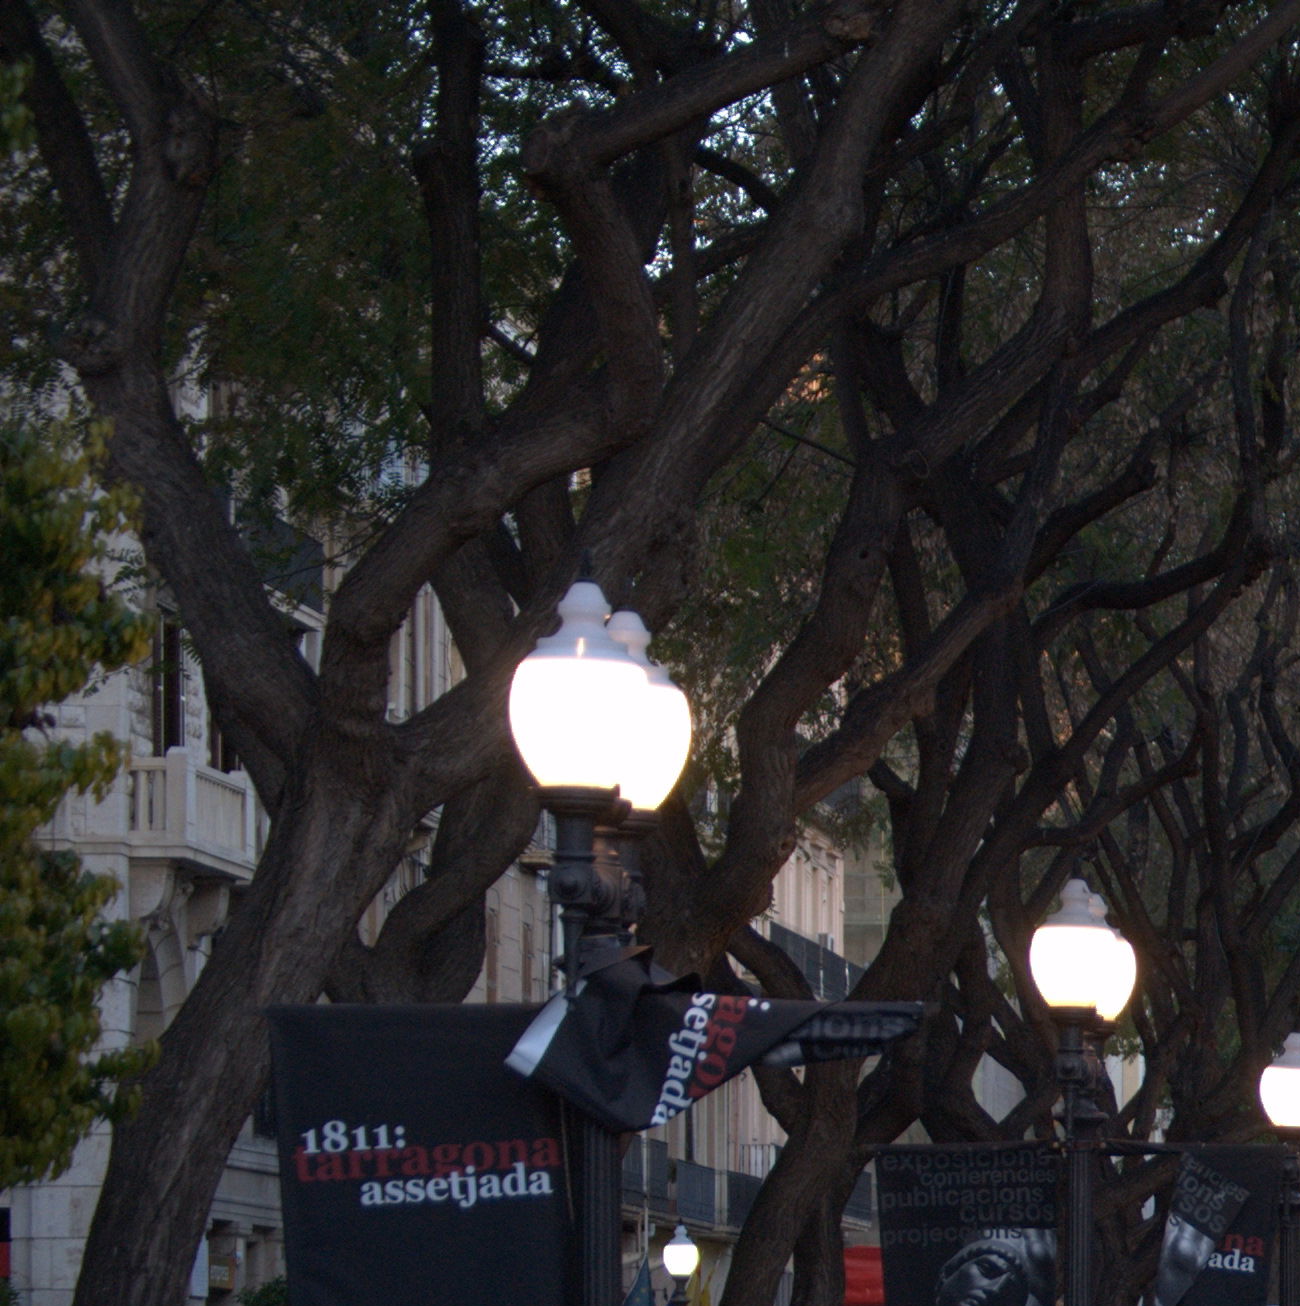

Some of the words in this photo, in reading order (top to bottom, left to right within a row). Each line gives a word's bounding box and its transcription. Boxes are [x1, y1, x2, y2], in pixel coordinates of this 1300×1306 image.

[301, 1120, 406, 1155] 1811:
[293, 1133, 563, 1184] tarragona
[359, 1161, 554, 1209] assetjada
[880, 1183, 1044, 1213] publicacions
[959, 1201, 1056, 1224] cursos
[882, 1222, 1023, 1247] projeccions
